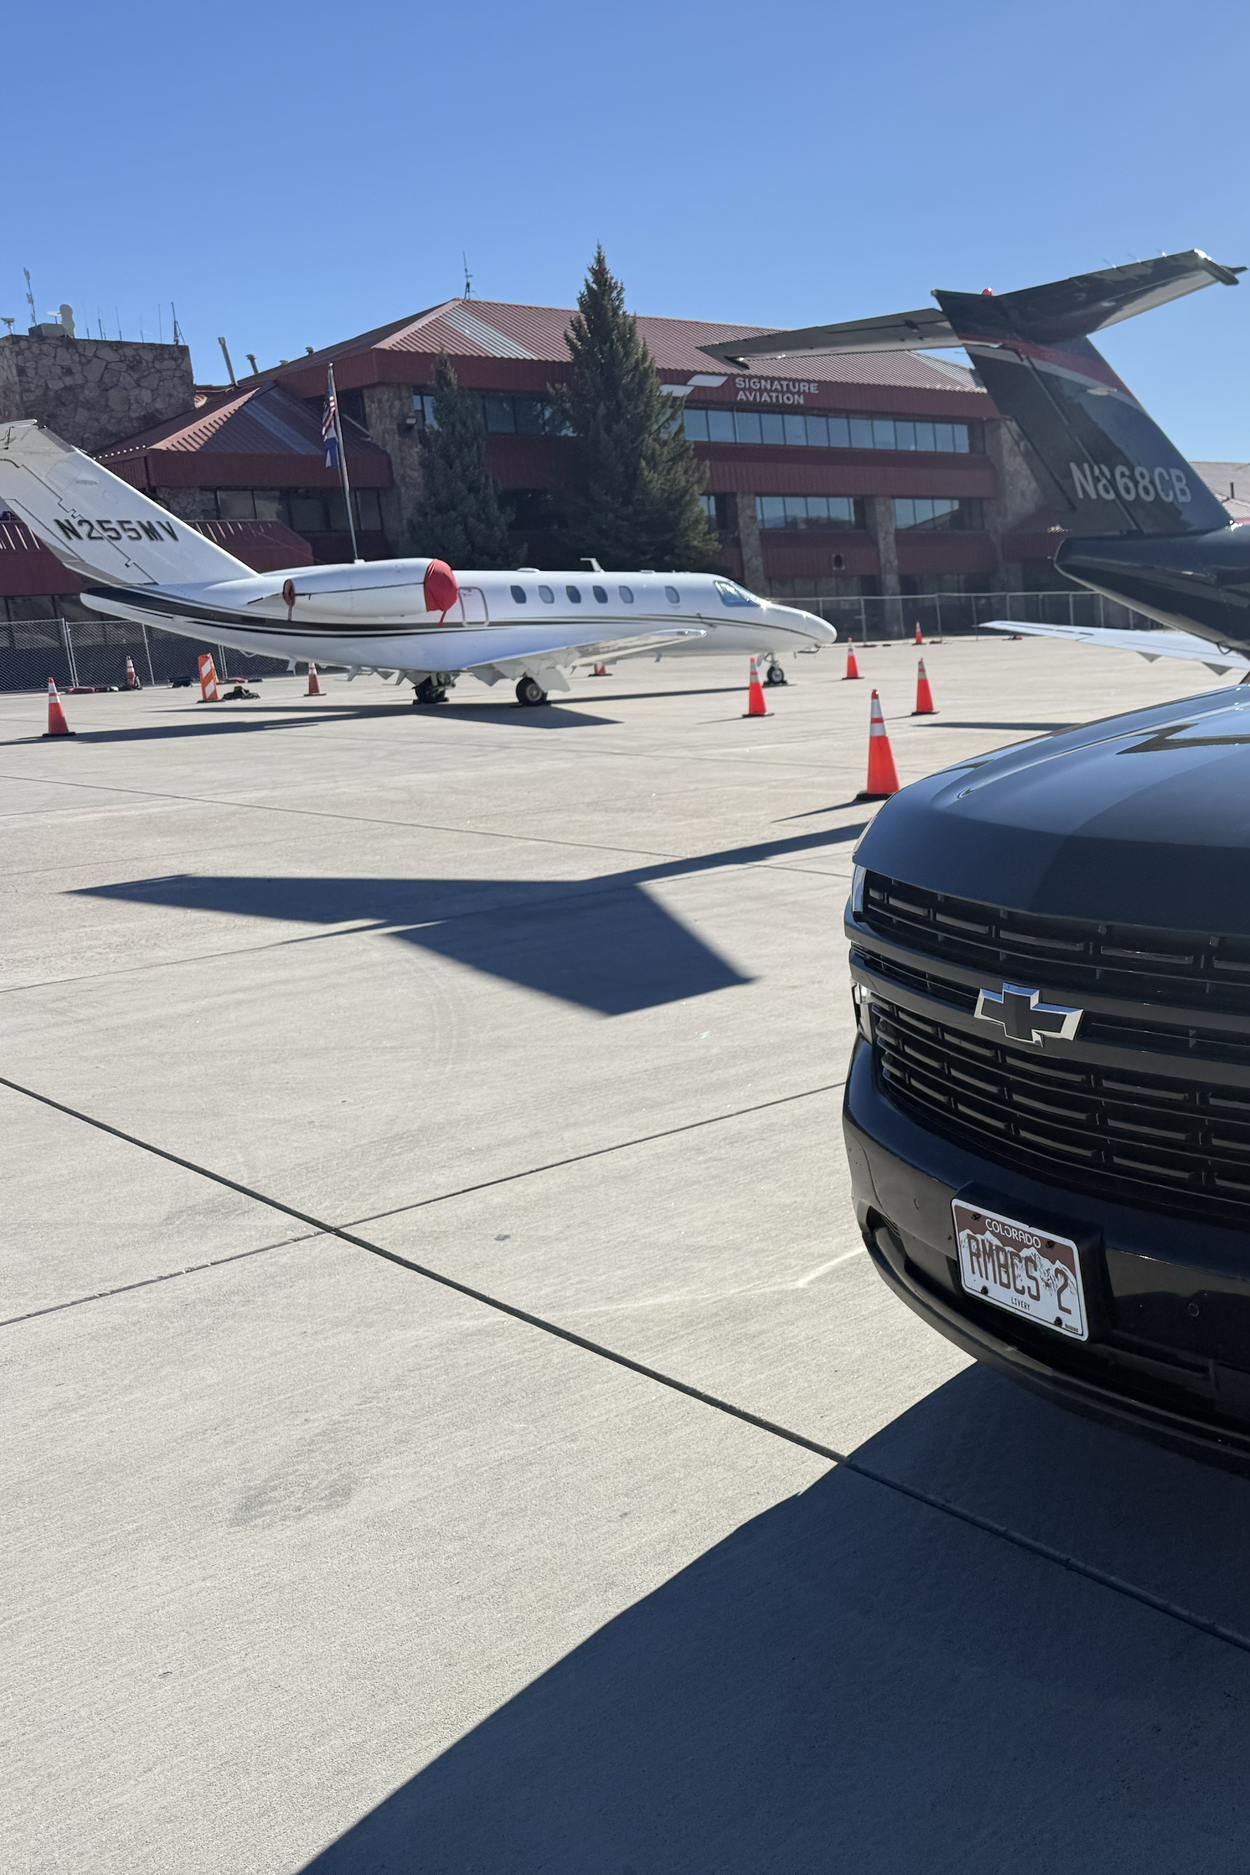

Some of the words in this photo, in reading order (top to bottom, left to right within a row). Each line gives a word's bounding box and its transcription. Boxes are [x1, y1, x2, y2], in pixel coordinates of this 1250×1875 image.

[735, 377, 819, 393] SIGNATURE
[737, 390, 804, 404] AVIATION
[1069, 462, 1191, 502] N868CB
[53, 519, 179, 541] N255MV
[985, 1218, 1041, 1249] COLORADO
[1010, 1296, 1030, 1311] LIVERY
